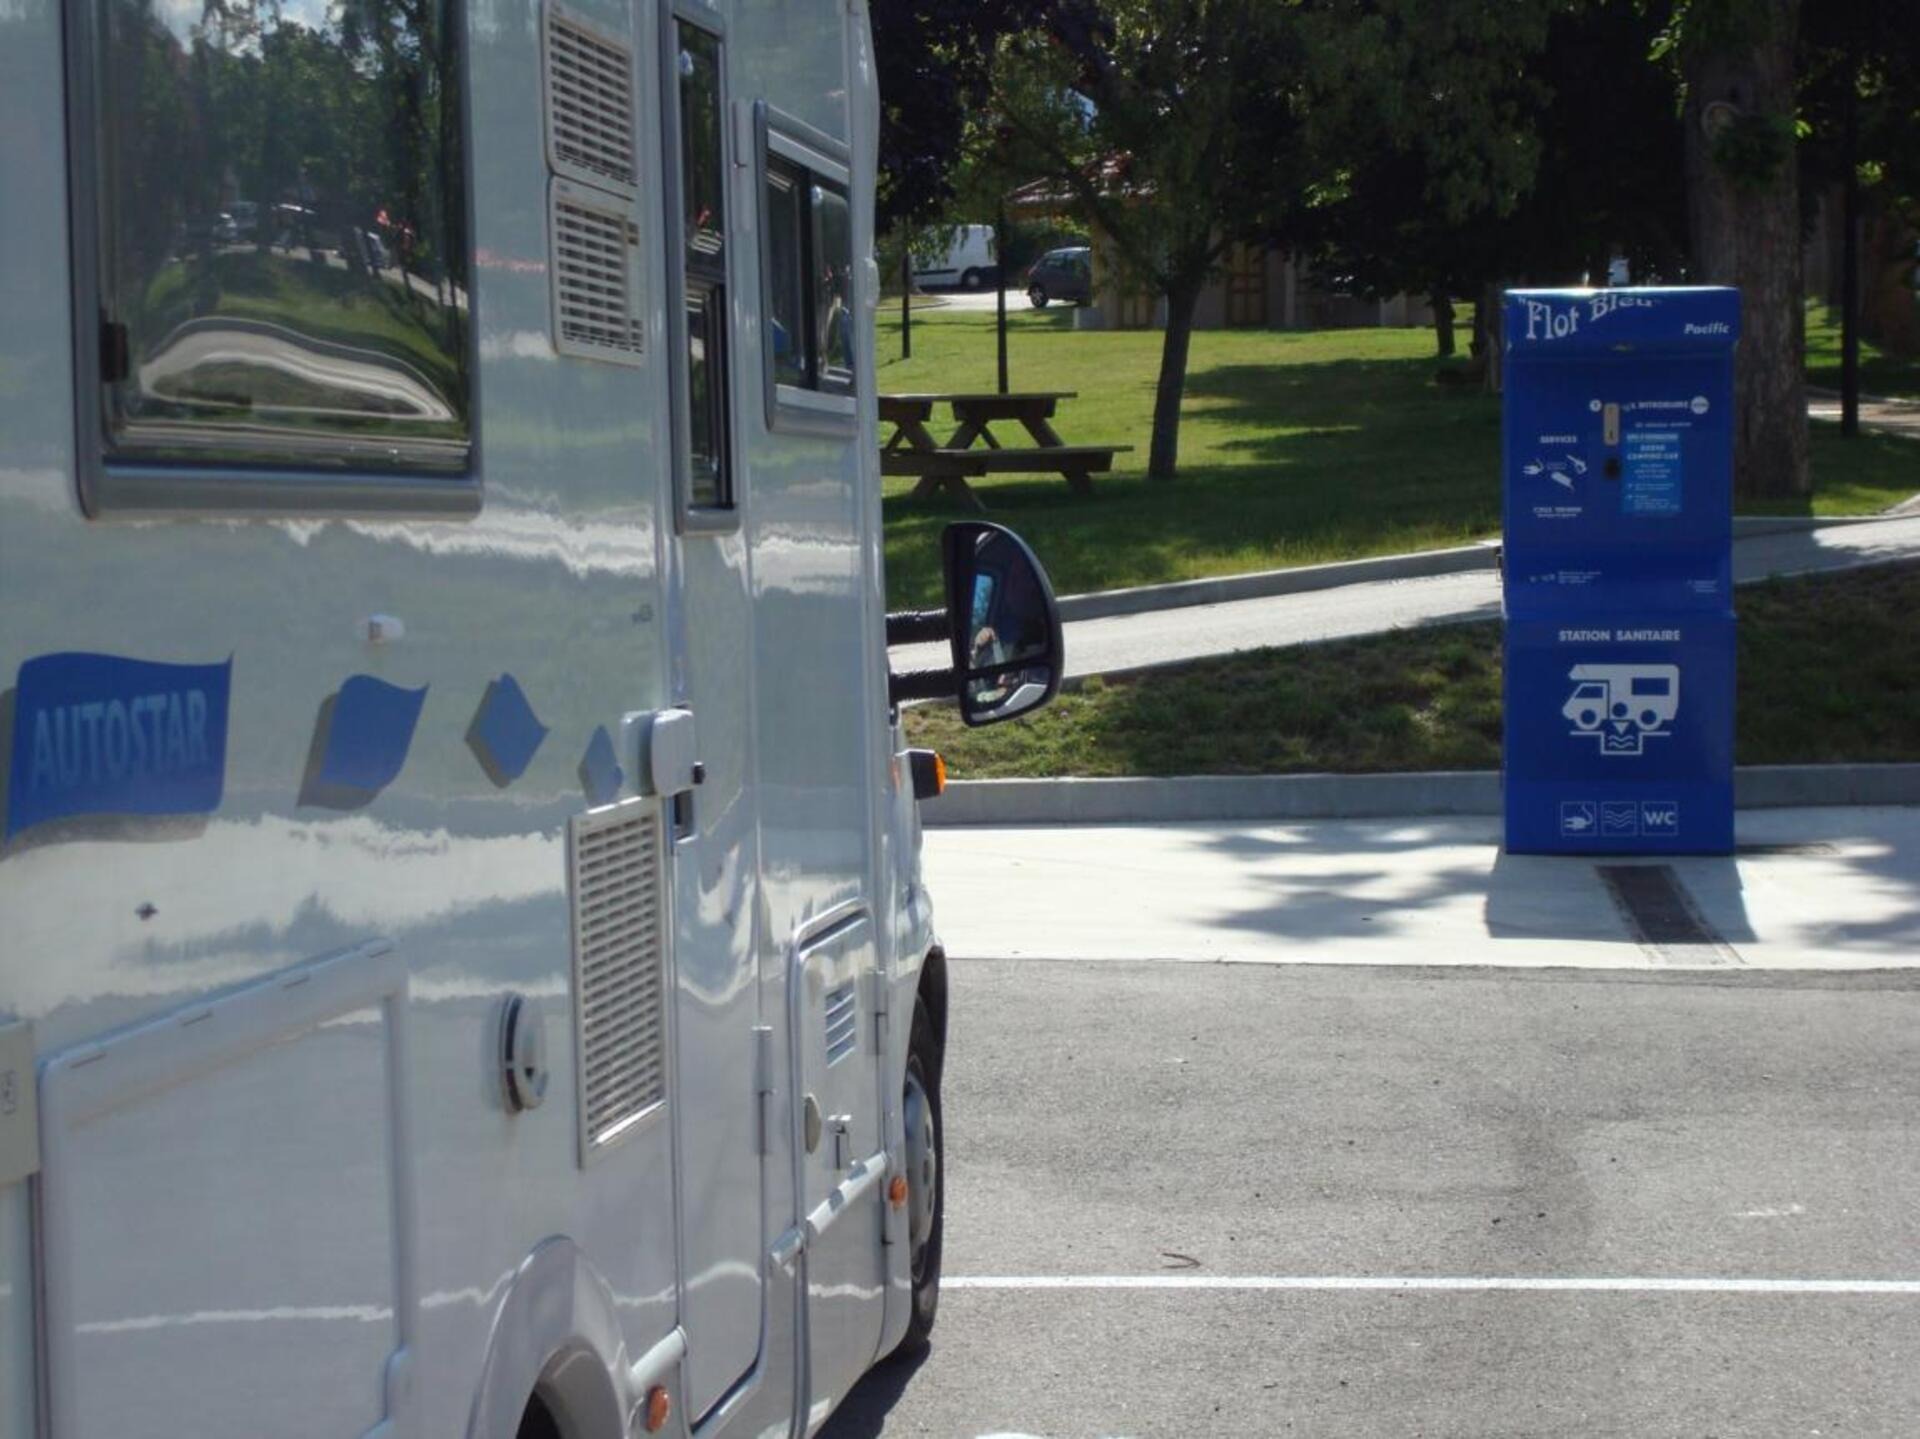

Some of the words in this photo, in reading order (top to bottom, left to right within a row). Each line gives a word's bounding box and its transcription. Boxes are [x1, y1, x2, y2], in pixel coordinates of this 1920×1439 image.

[1683, 322, 1730, 335] Pacific
[1558, 630, 1611, 642] STATION
[1616, 630, 1681, 642] SANITAIRE
[31, 688, 210, 792] AUTOSTAR
[1644, 811, 1676, 826] WC
